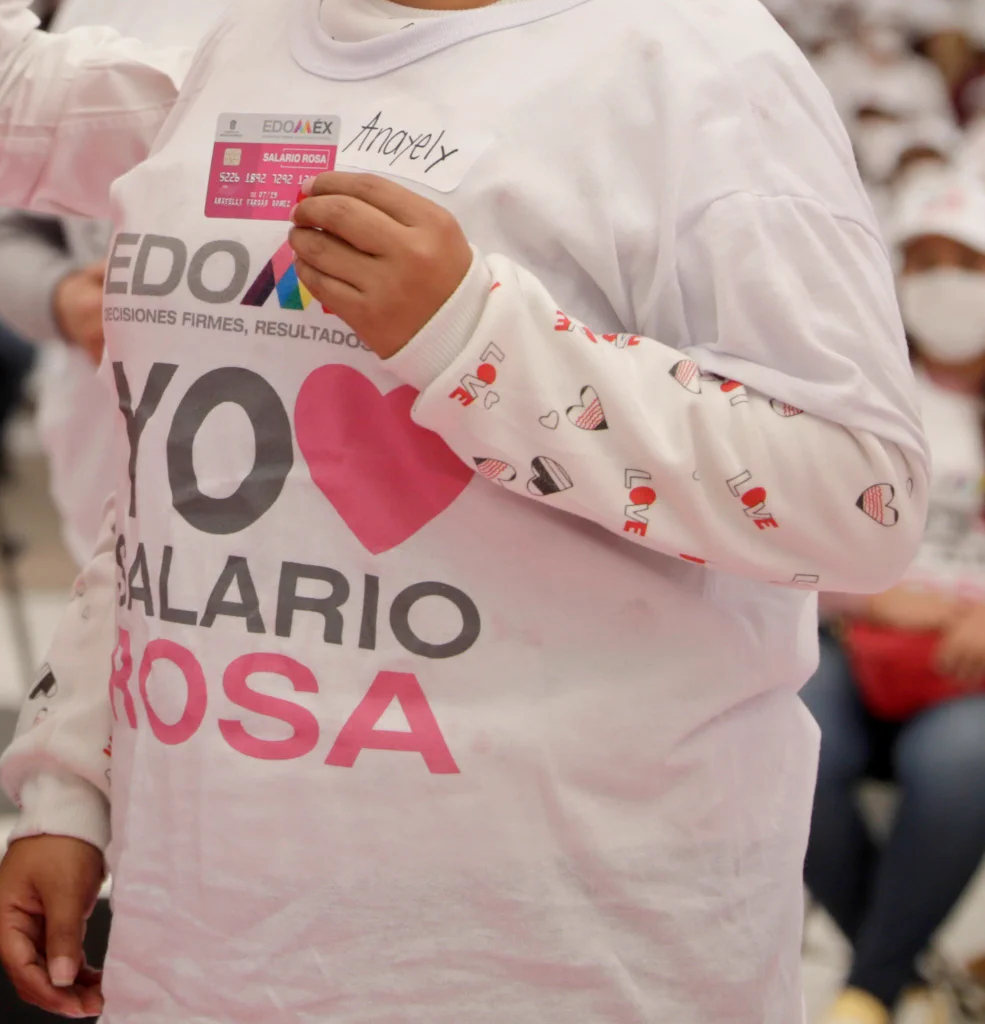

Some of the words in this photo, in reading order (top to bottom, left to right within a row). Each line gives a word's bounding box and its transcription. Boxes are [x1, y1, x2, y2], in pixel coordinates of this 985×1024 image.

[262, 118, 333, 135] EDOMÉX
[262, 153, 300, 163] SALARIO
[301, 154, 327, 164] ROSA
[342, 111, 458, 173] Anayely
[182, 311, 249, 336] FIRMES,
[448, 341, 506, 407] LOVE
[112, 361, 294, 535] YO
[623, 468, 657, 537] LOVE
[726, 470, 780, 531] LOVE
[116, 533, 481, 659] SALARIO
[109, 626, 461, 775] ROSA
